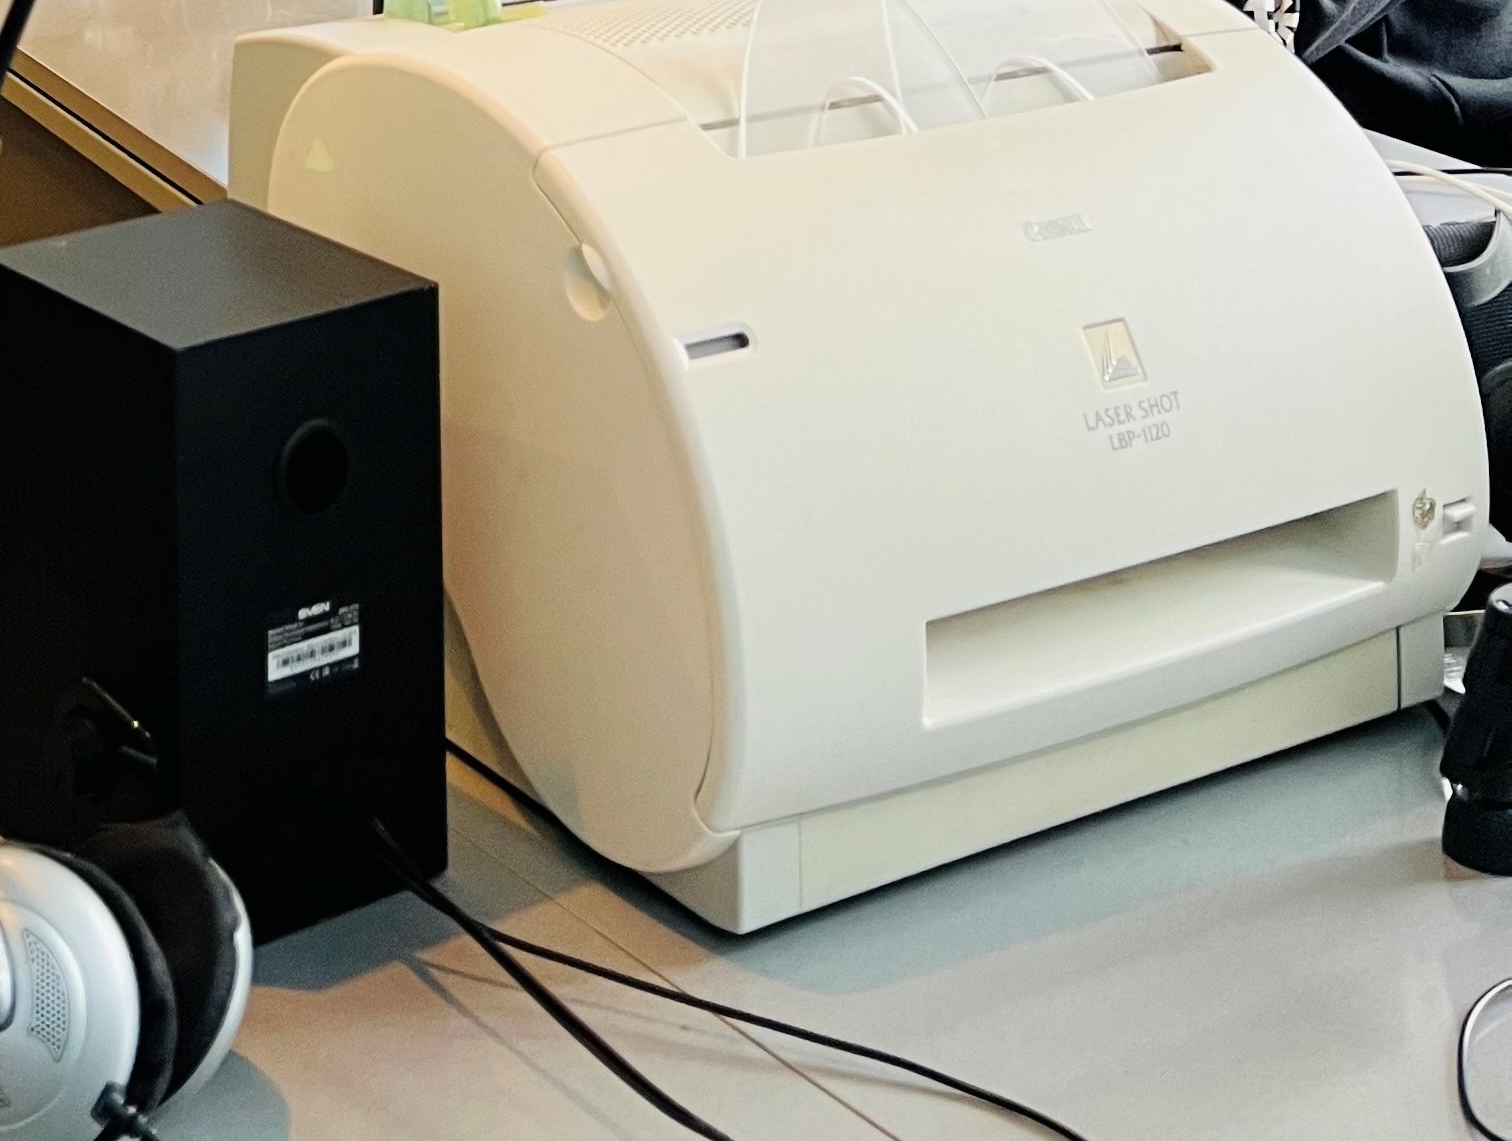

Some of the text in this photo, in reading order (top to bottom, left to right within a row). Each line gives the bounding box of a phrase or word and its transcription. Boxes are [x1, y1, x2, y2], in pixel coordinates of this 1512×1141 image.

[1082, 391, 1181, 432] LASER SHOT
[1108, 420, 1171, 452] LBP-1120
